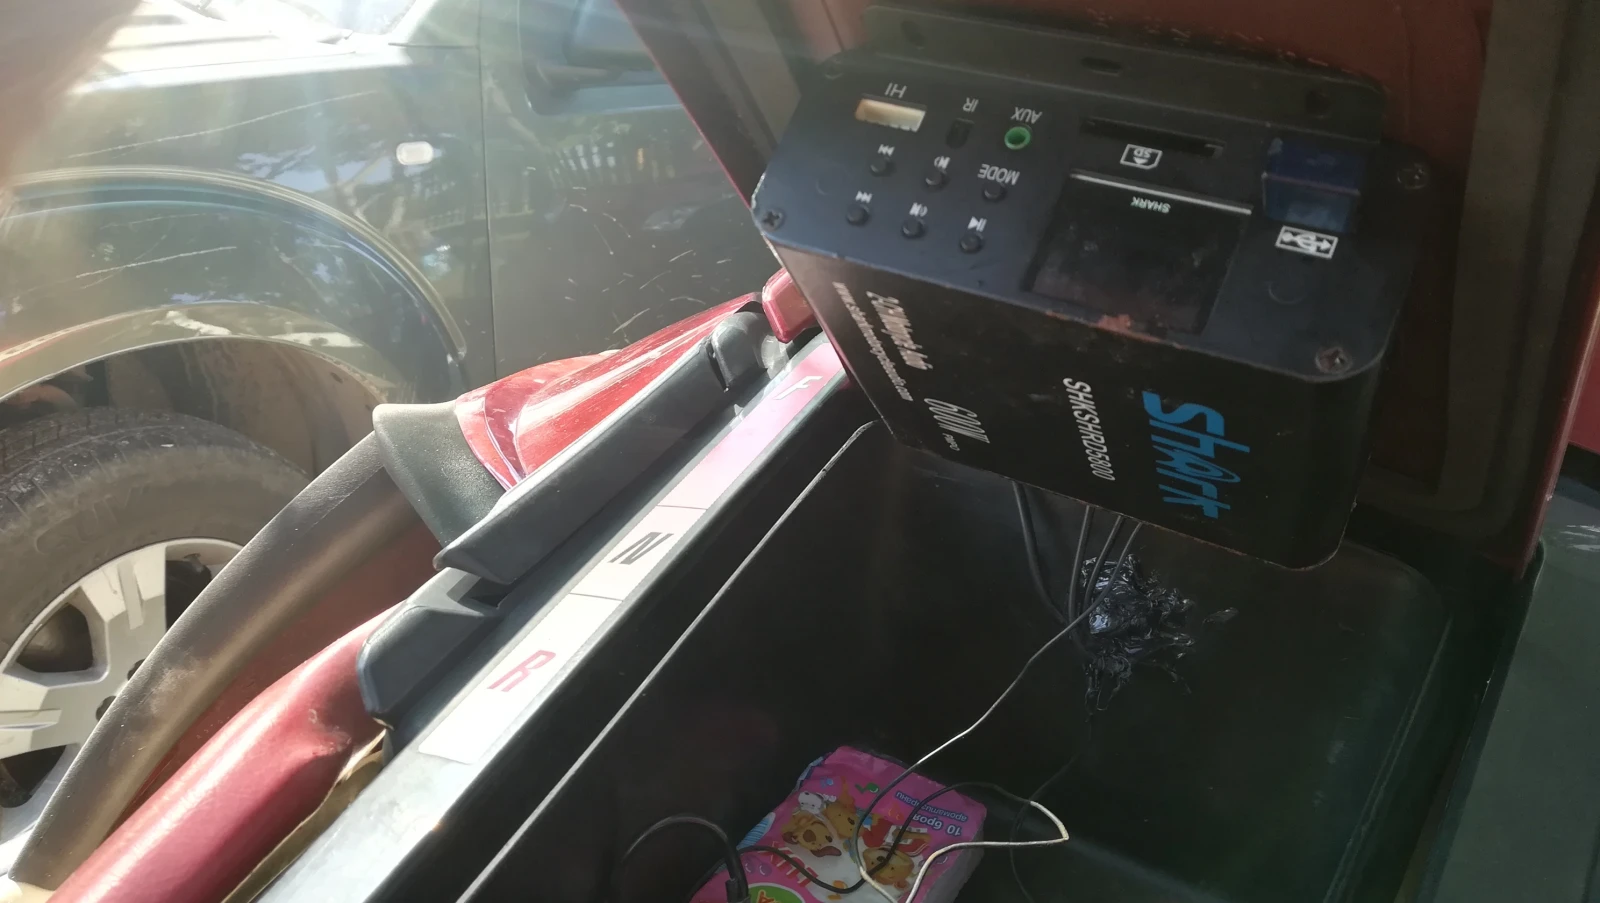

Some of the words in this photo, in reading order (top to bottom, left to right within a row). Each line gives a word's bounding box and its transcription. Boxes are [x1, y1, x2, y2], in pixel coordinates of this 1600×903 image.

[884, 82, 907, 98] HI
[962, 97, 979, 113] IR
[1010, 106, 1043, 124] AUX
[1133, 146, 1153, 158] SD
[977, 163, 1020, 185] MODE
[1130, 196, 1171, 214] SHARK
[773, 374, 823, 401] F
[1062, 377, 1116, 481] SHKSHRD5800
[608, 531, 674, 566] N
[487, 649, 557, 692] R
[912, 813, 943, 830] броя
[946, 824, 962, 837] 10
